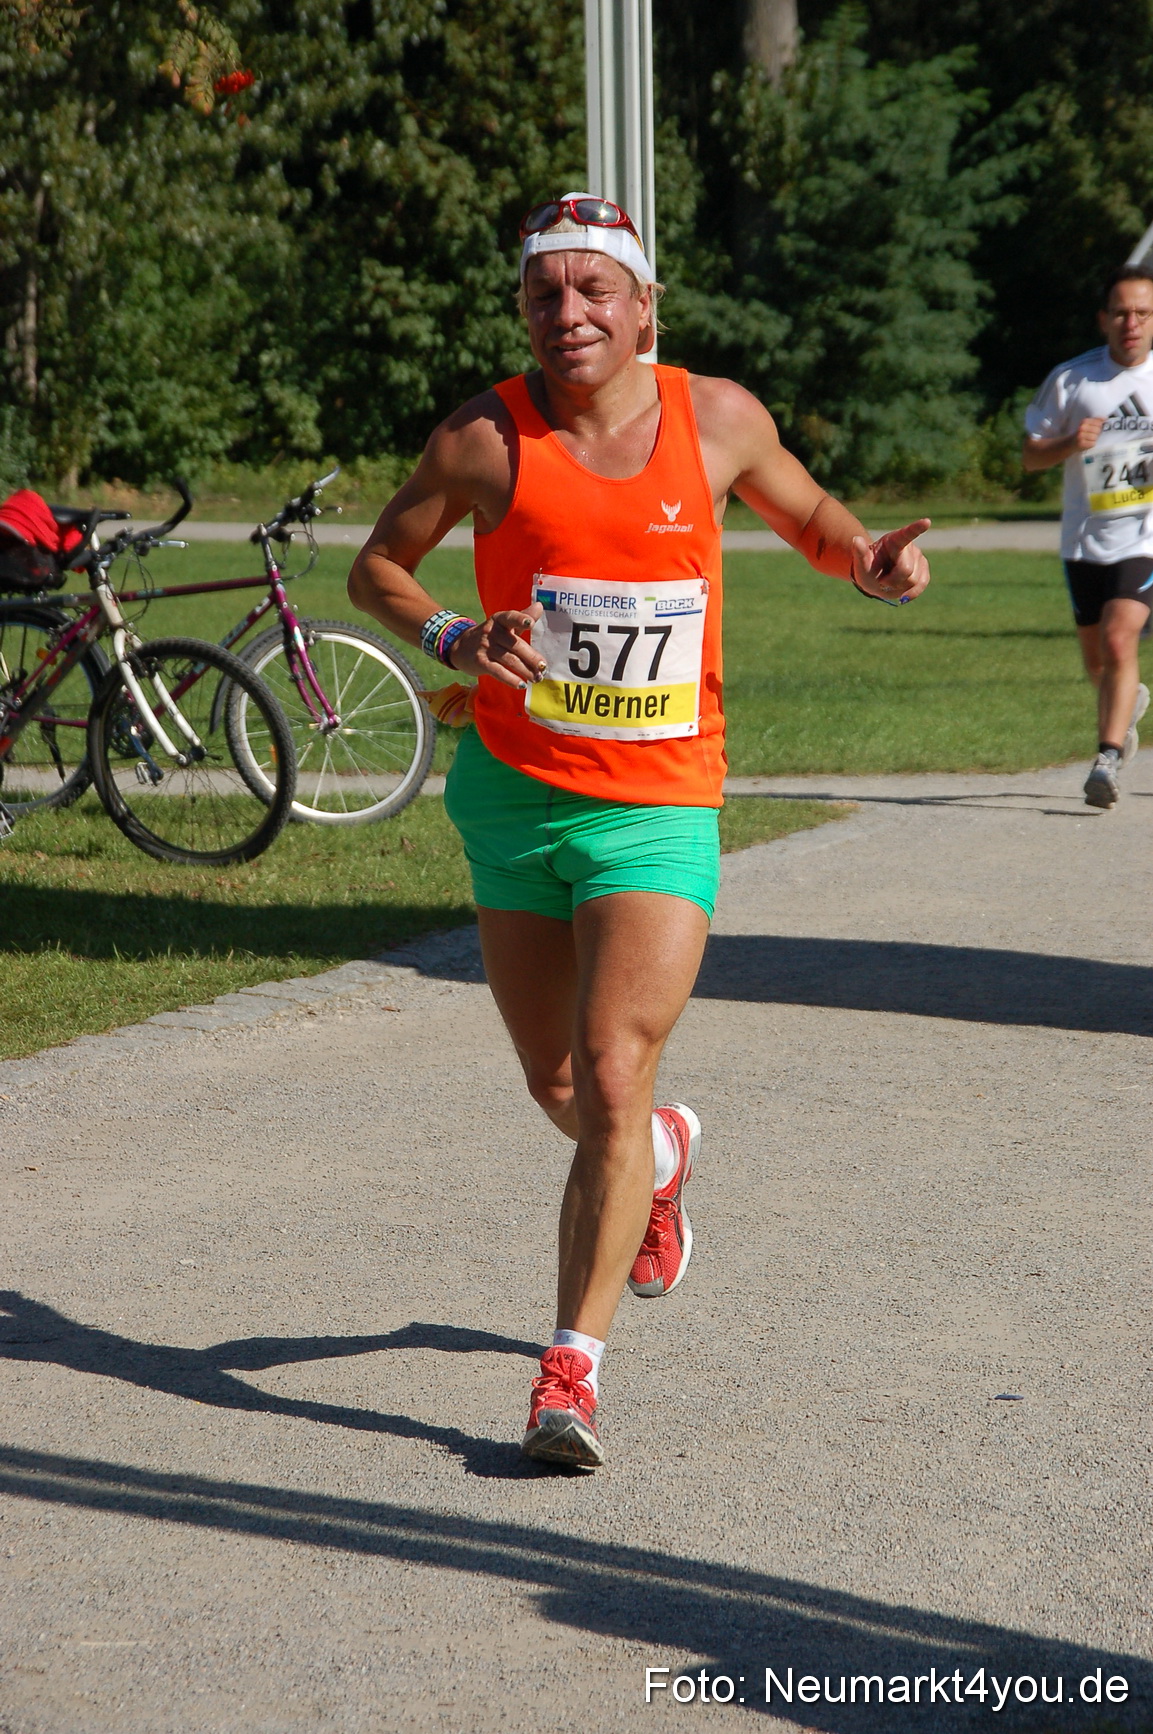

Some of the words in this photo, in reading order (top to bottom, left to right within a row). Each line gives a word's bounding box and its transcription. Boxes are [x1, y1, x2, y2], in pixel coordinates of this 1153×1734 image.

[1102, 460, 1148, 489] 244
[558, 608, 637, 619] AKTIENGESELLSCHAFT
[559, 592, 637, 610] PFLEIDERER
[568, 621, 672, 682] 577
[563, 683, 670, 719] Werner
